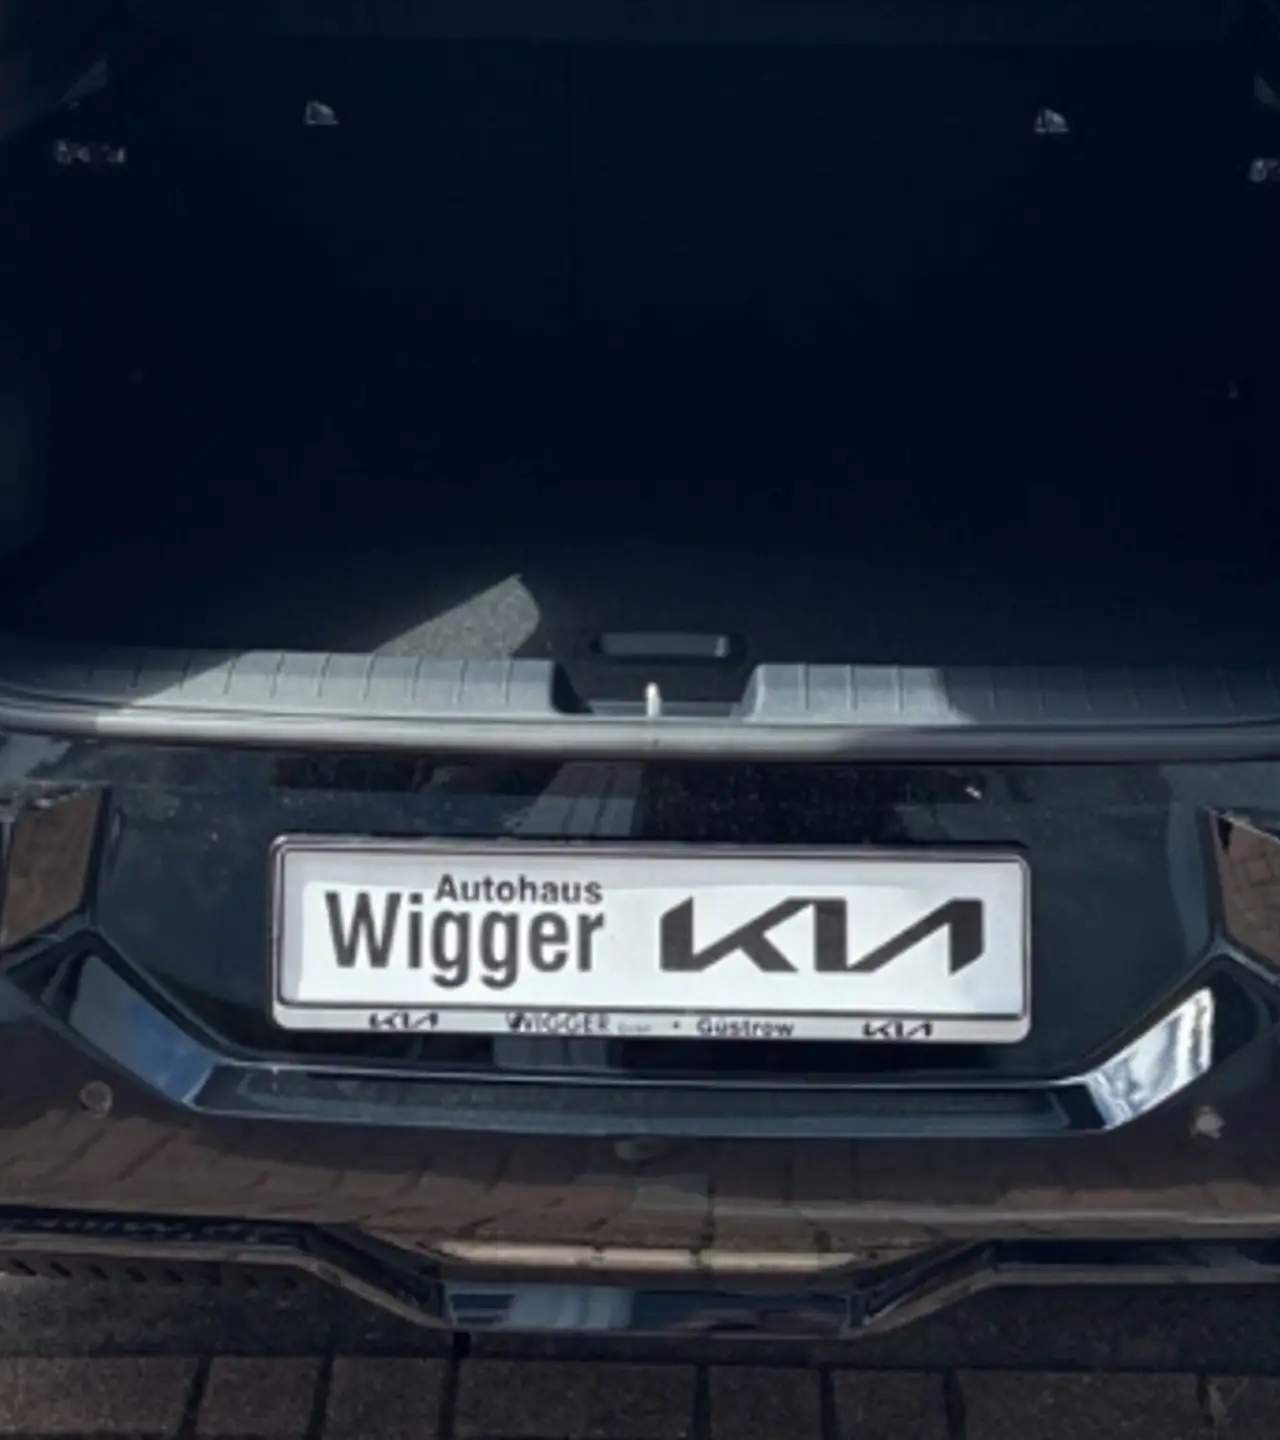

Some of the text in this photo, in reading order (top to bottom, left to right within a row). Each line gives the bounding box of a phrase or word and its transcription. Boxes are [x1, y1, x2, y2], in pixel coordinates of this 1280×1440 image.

[433, 873, 605, 905] Autohaus
[323, 890, 986, 990] Wigger KIA
